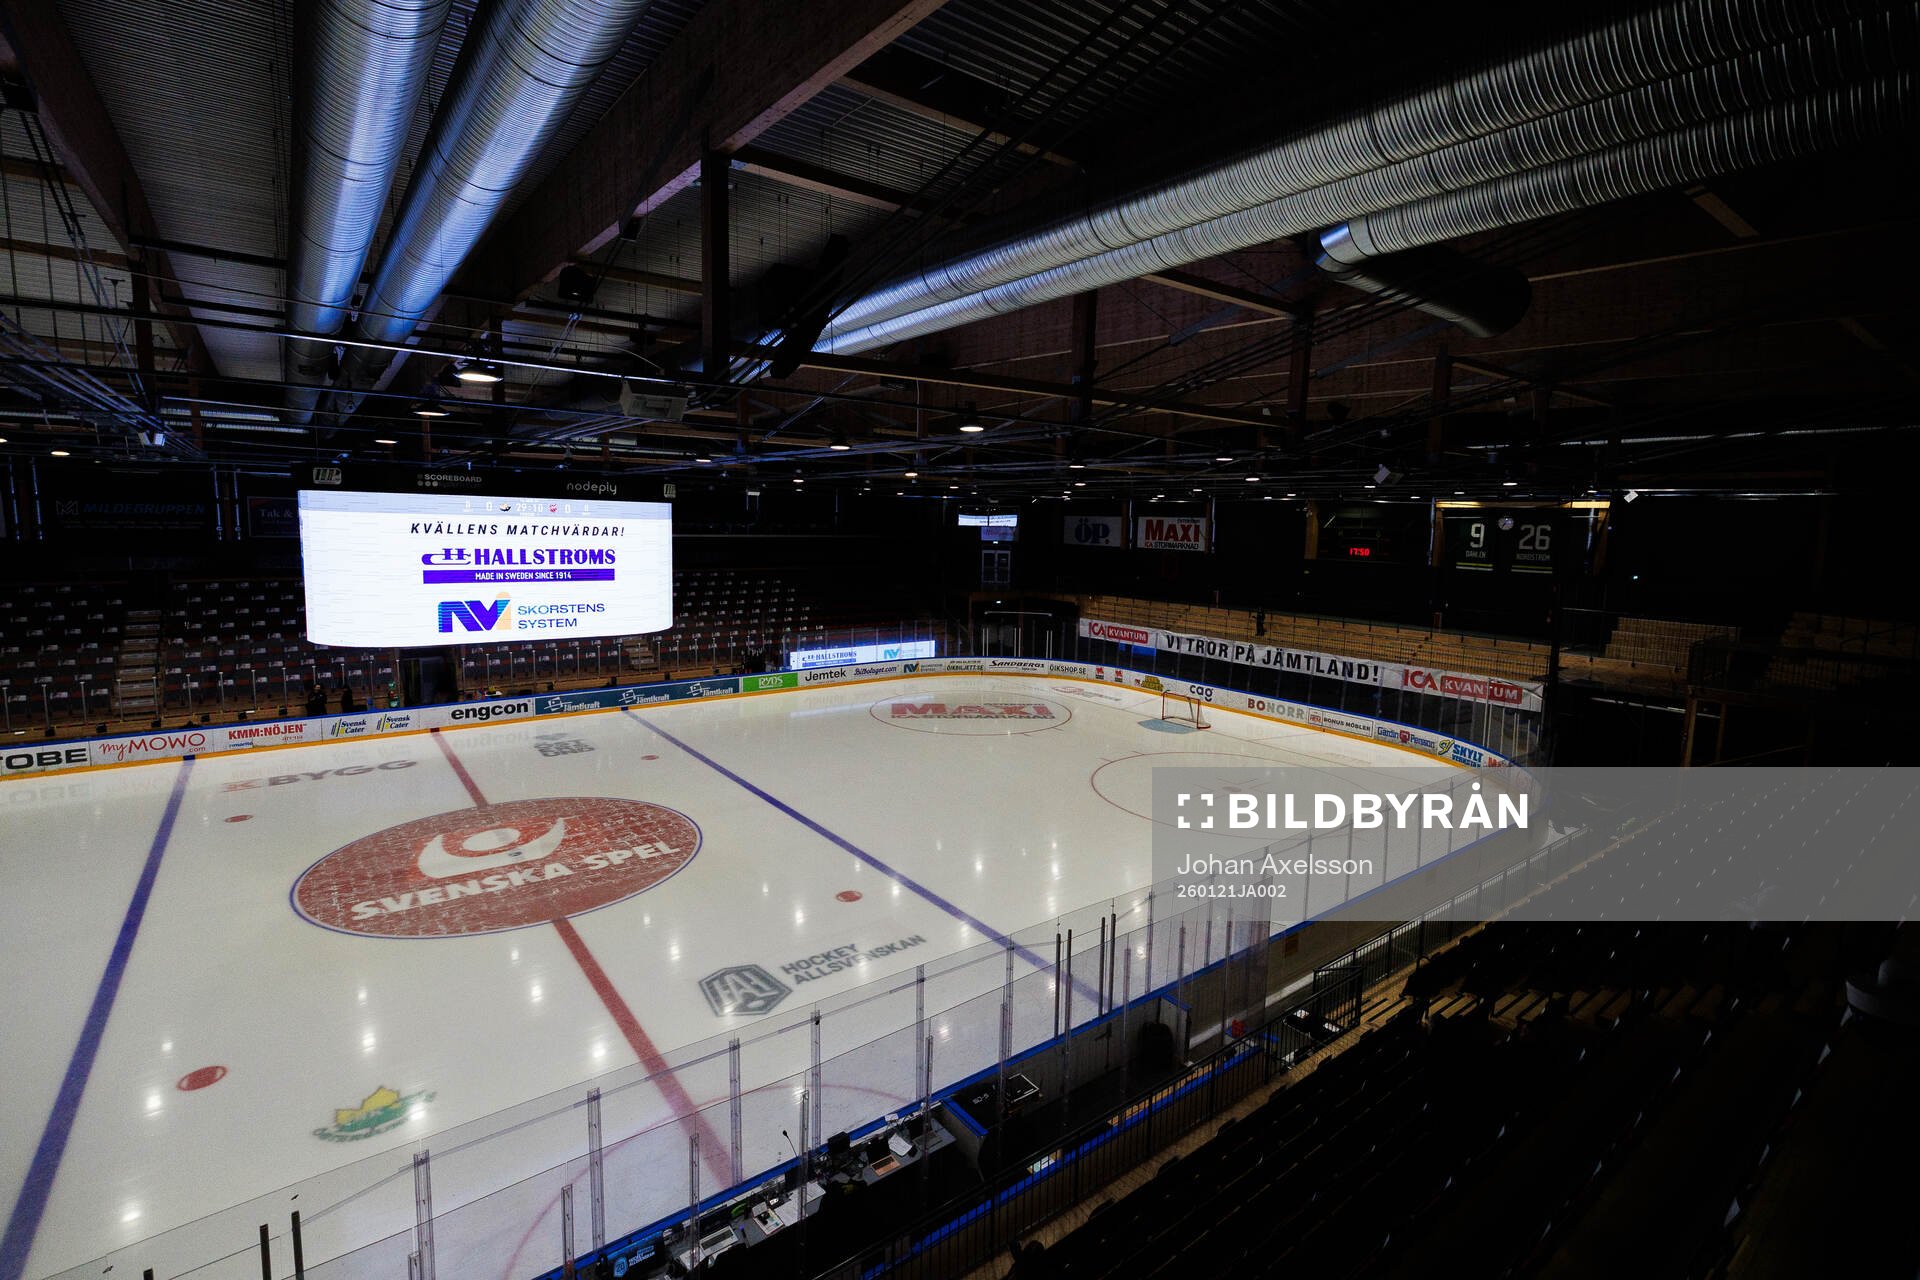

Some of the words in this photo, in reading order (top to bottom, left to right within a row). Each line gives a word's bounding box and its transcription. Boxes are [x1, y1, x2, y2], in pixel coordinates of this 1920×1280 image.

[424, 473, 482, 483] SCOREBOARD
[566, 481, 617, 495] nodeply
[516, 502, 543, 513] 29:10
[410, 521, 498, 535] KVÄLLENS
[506, 524, 625, 537] MATCHVÄRDAR!
[1145, 519, 1200, 542] MAXI
[1469, 522, 1486, 549] 9
[1518, 523, 1552, 551] 26
[474, 548, 616, 565] HALLSTRÖMS
[475, 572, 495, 580] MADE
[496, 572, 504, 580] IN
[505, 572, 534, 580] SWEDEN
[535, 572, 554, 580] SINCE
[555, 571, 572, 580] 1914
[517, 603, 606, 615] SKORSTENS
[517, 618, 578, 630] SYSTEM
[1108, 628, 1148, 642] KVANTUM
[1187, 637, 1229, 658] TROR
[1234, 641, 1256, 663] PÅ
[1262, 648, 1379, 682] JÄMTLAND!
[805, 668, 847, 683] Jemtek
[1403, 668, 1438, 691] ICA
[1443, 679, 1518, 700] KVANTUM
[636, 693, 670, 704] Jämtkraft
[702, 687, 734, 697] Jämtkraft
[450, 701, 529, 722] engcon
[563, 701, 600, 713] Jämtkraft
[891, 703, 1053, 715] MAXI
[1247, 698, 1305, 720] BONORR
[340, 719, 367, 728] Svensk
[387, 715, 411, 724] Svensk
[389, 721, 408, 730] Cater
[228, 723, 304, 740] KMM:NÖJEN
[344, 726, 365, 734] Cater
[1452, 743, 1484, 762] SKYLT
[268, 759, 417, 787] BYGG
[350, 861, 575, 921] SVENSKA
[583, 840, 682, 870] SPEL
[780, 943, 858, 975] HOCKEY
[791, 934, 928, 985] ALLSVENSKAN
